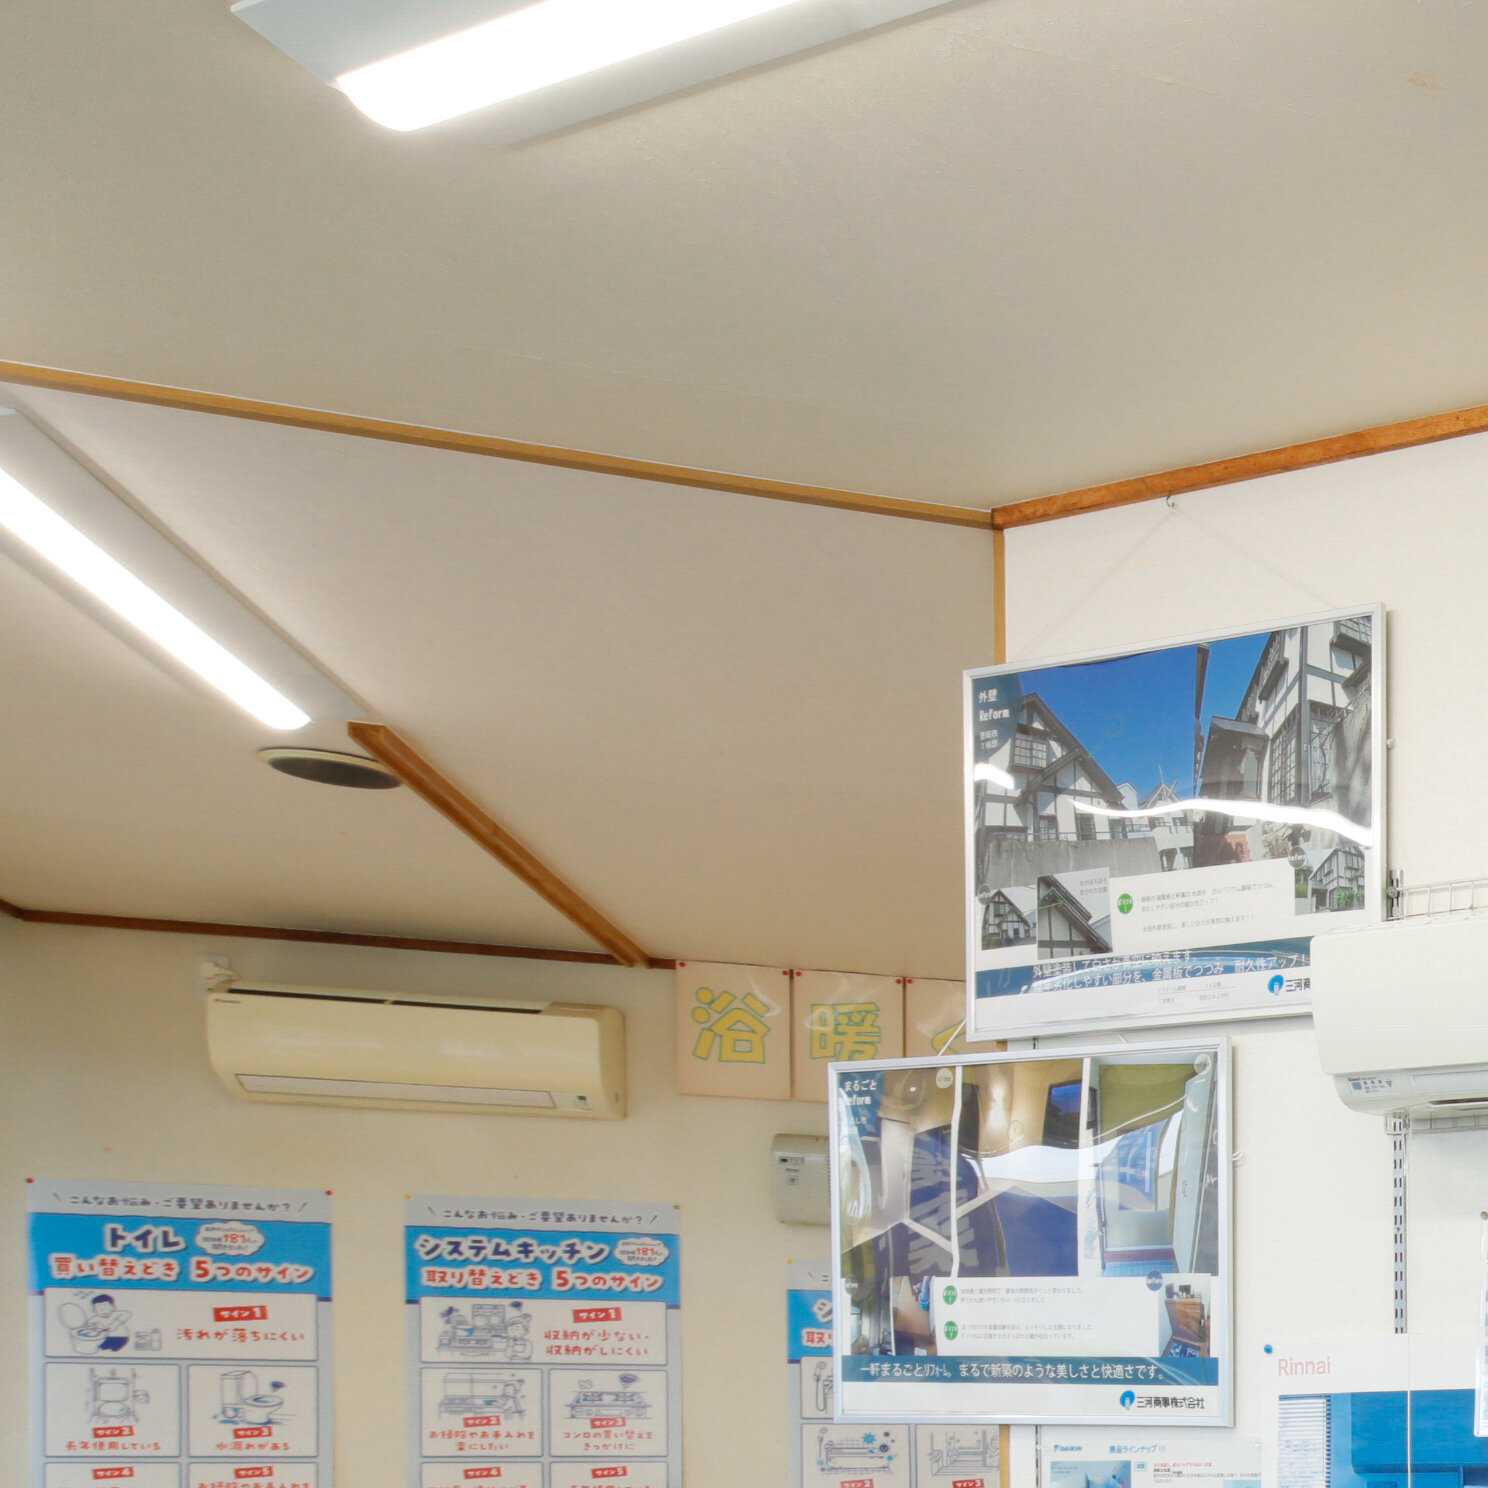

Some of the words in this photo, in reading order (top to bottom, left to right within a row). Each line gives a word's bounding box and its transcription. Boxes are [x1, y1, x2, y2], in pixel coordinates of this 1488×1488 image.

[691, 987, 771, 1064] 浴
[810, 1002, 881, 1061] 暖
[844, 1080, 878, 1091] まるごと
[109, 1227, 180, 1248] トイレ
[419, 1237, 606, 1260] システムキッチン
[54, 1257, 176, 1277] 買い替えどき
[195, 1260, 309, 1280] 5つのサイン
[426, 1269, 539, 1286] 取り替えどき
[555, 1269, 661, 1288] 5つのサイン
[177, 1328, 304, 1343] 汚れが落ちにくい
[959, 1363, 1167, 1380] まるで新築のような美しさと快適さです。
